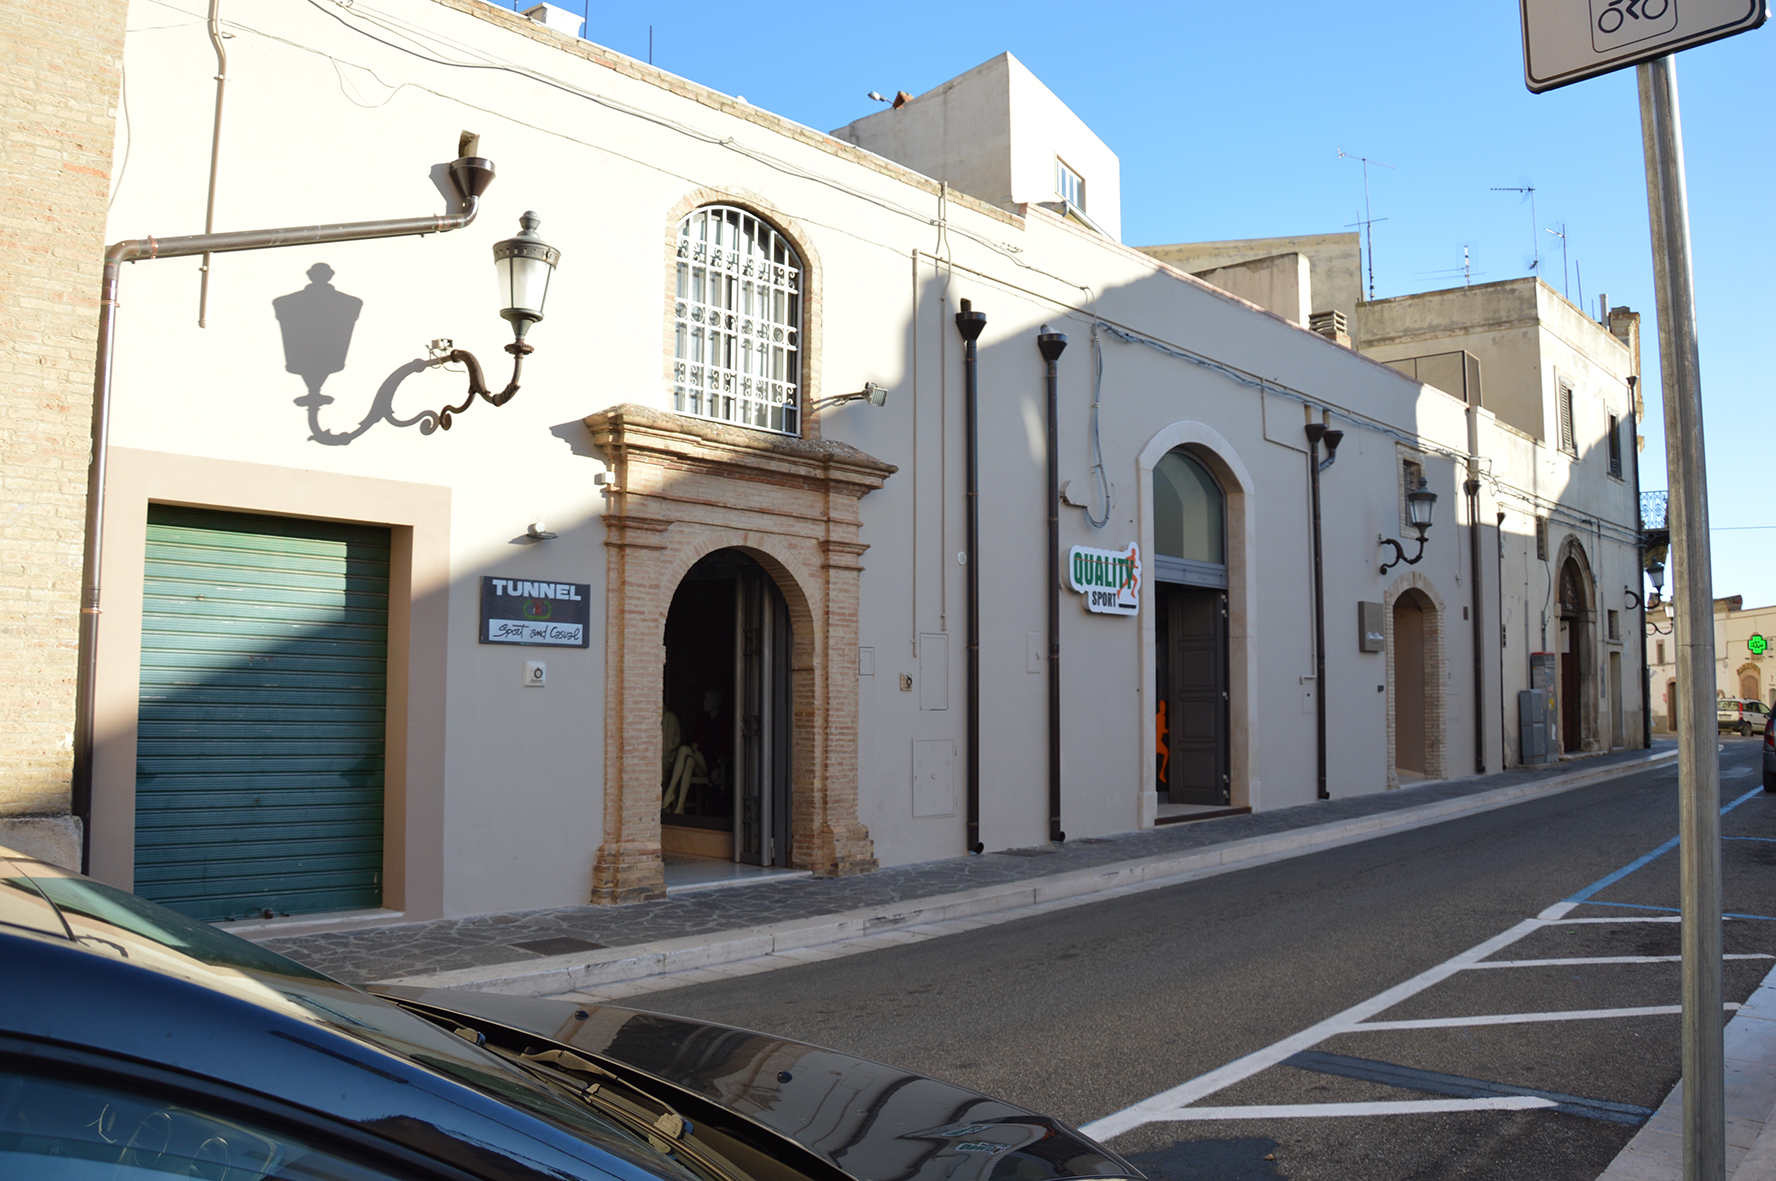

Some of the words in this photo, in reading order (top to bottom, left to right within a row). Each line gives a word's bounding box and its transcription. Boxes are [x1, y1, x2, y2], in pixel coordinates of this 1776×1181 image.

[1074, 552, 1135, 589] QUALITY
[492, 579, 581, 600] TUNNEL
[1092, 590, 1117, 608] SPORT
[493, 624, 530, 639] Sport
[530, 625, 549, 640] and
[550, 626, 580, 641] Casual
